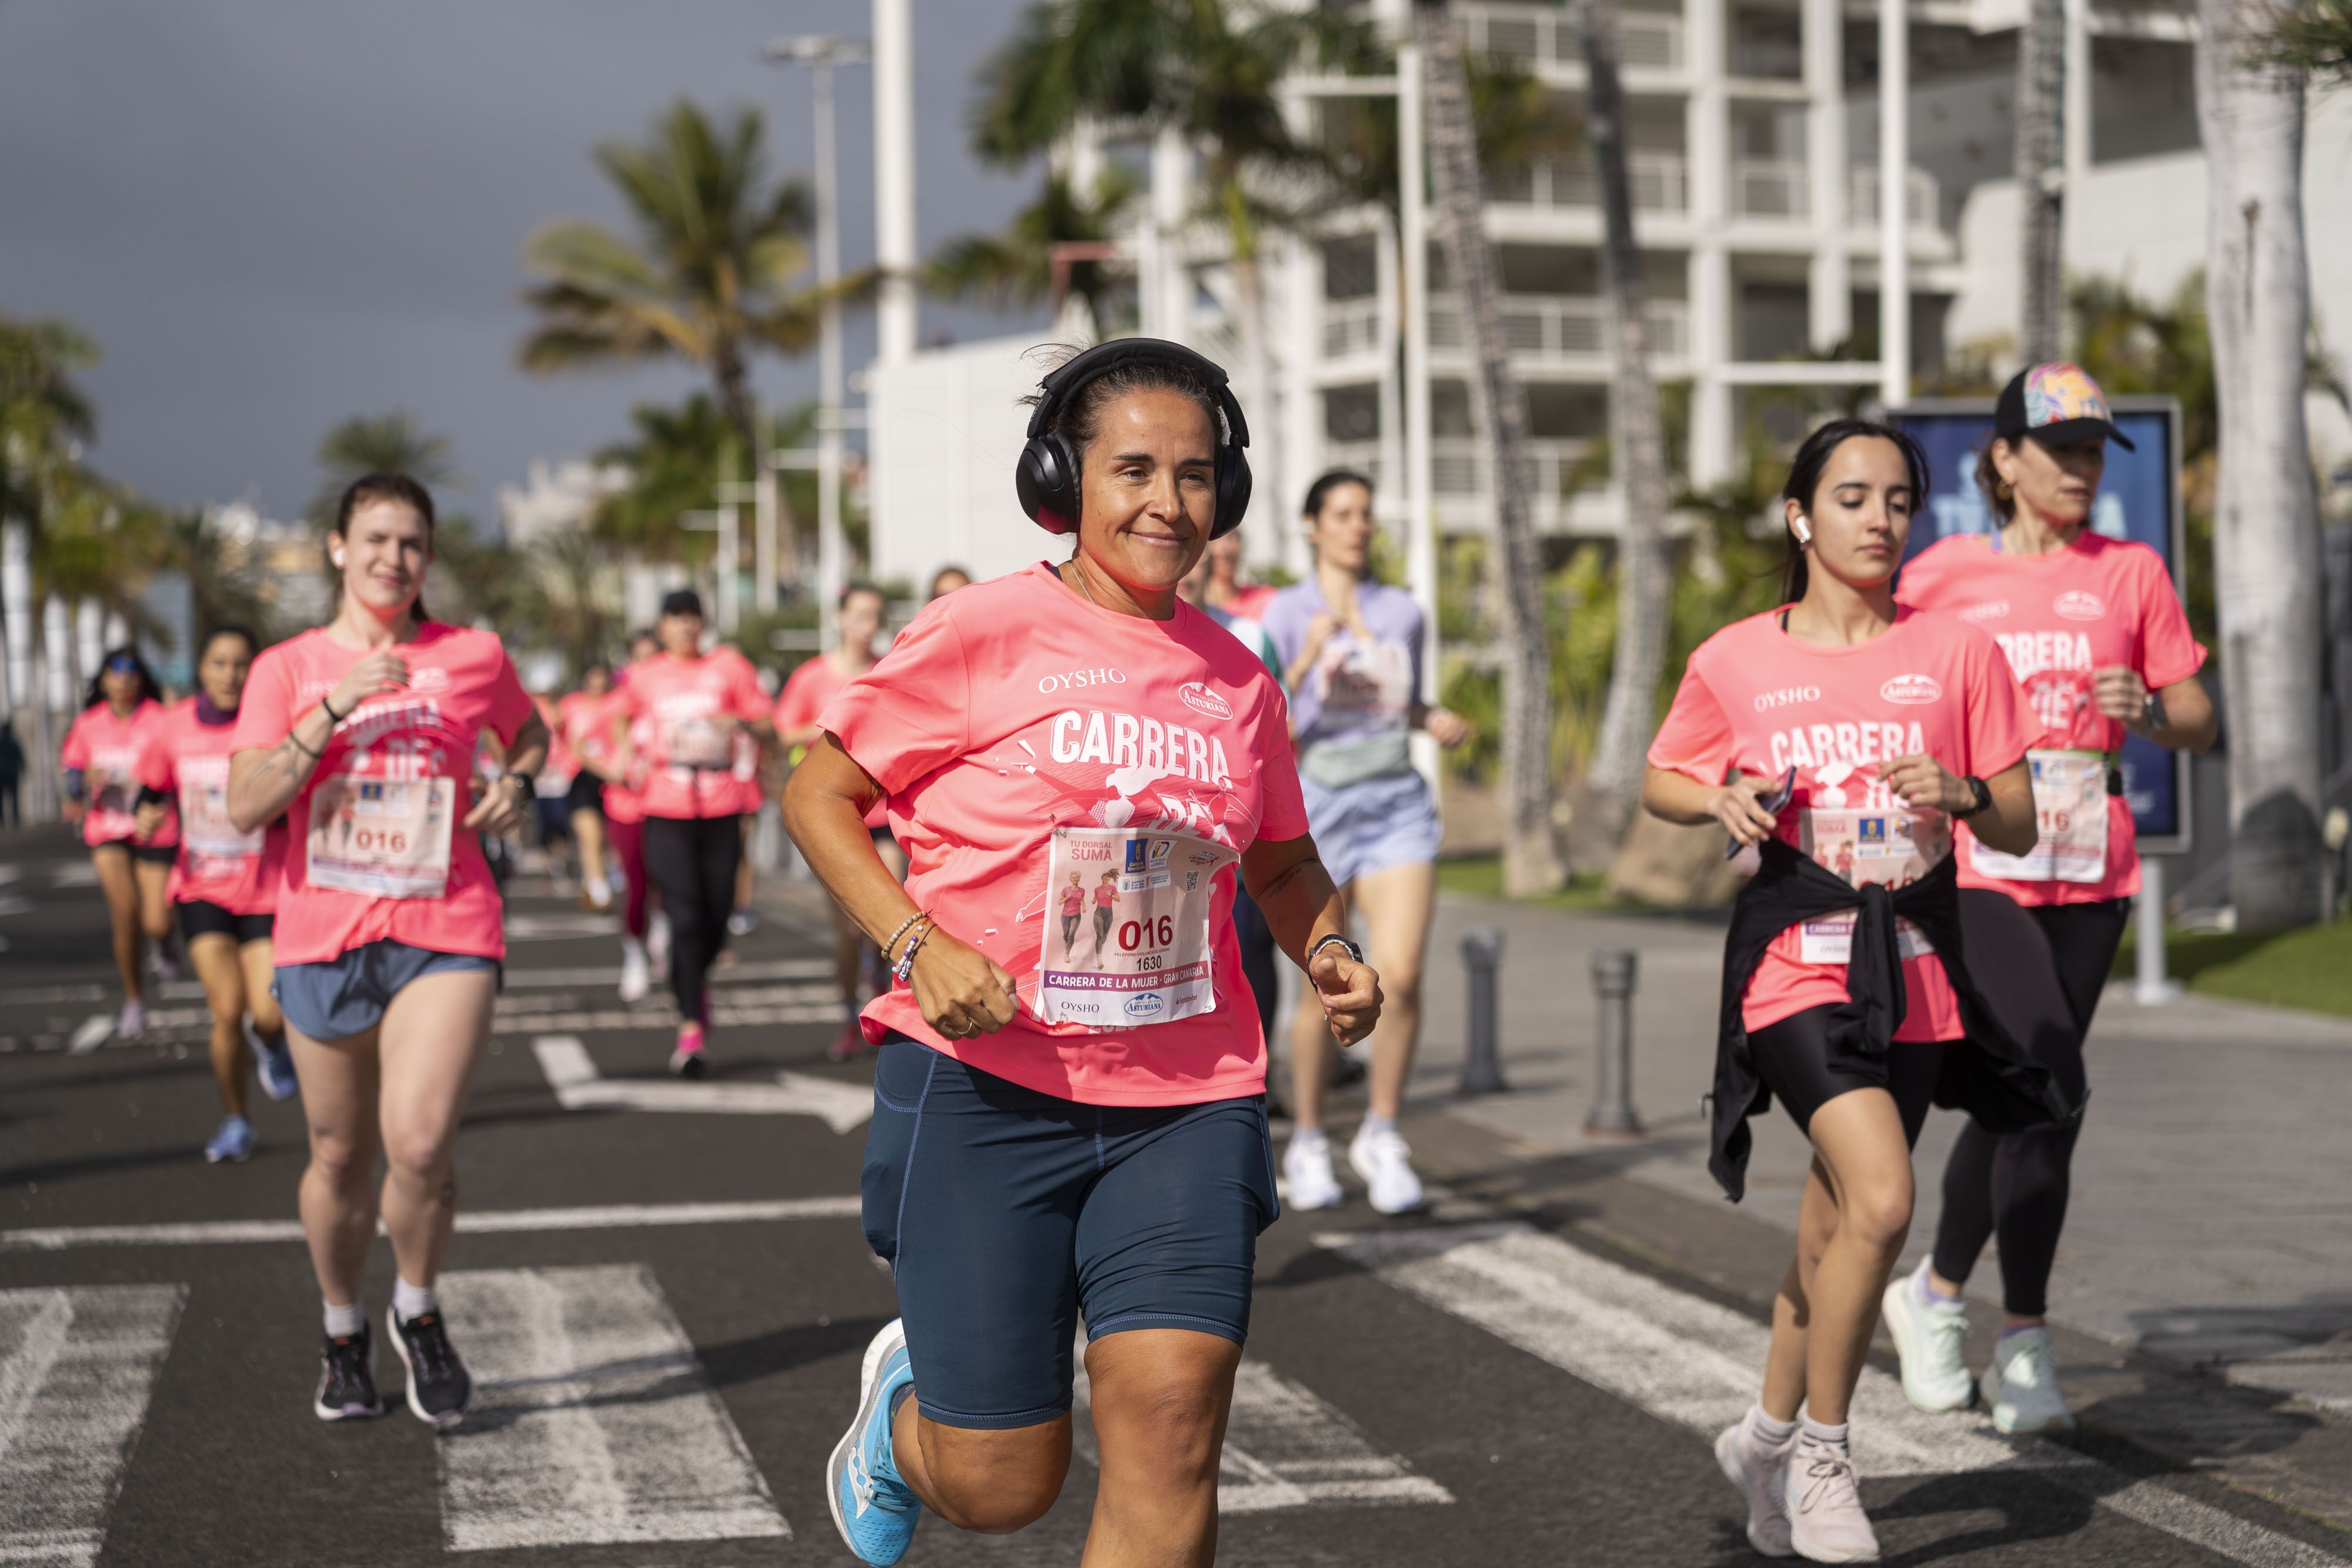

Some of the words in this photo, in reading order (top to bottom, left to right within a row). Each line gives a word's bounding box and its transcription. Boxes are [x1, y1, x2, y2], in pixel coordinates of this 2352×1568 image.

[1038, 668, 1126, 694] OYSHO
[1184, 689, 1231, 717] ASTURIANA
[1755, 686, 1820, 713] OYSHO
[1050, 710, 1233, 789] CARRERA
[1771, 721, 1926, 774] CARRERA
[2042, 808, 2072, 831] 16
[356, 829, 407, 852] 016
[1071, 848, 1112, 861] SUMA
[1118, 915, 1173, 951] 016
[1137, 955, 1162, 971] 1630
[1049, 975, 1095, 987] CARRERA
[1099, 977, 1112, 987] DE
[1115, 978, 1128, 988] LA
[1131, 976, 1158, 988] MUJER
[1164, 972, 1179, 984] GRAN
[1180, 965, 1204, 981] CANARIA
[1061, 1002, 1100, 1012] OYSHO
[1127, 1003, 1161, 1012] ASTURIANA
[1180, 994, 1198, 1004] Santander
